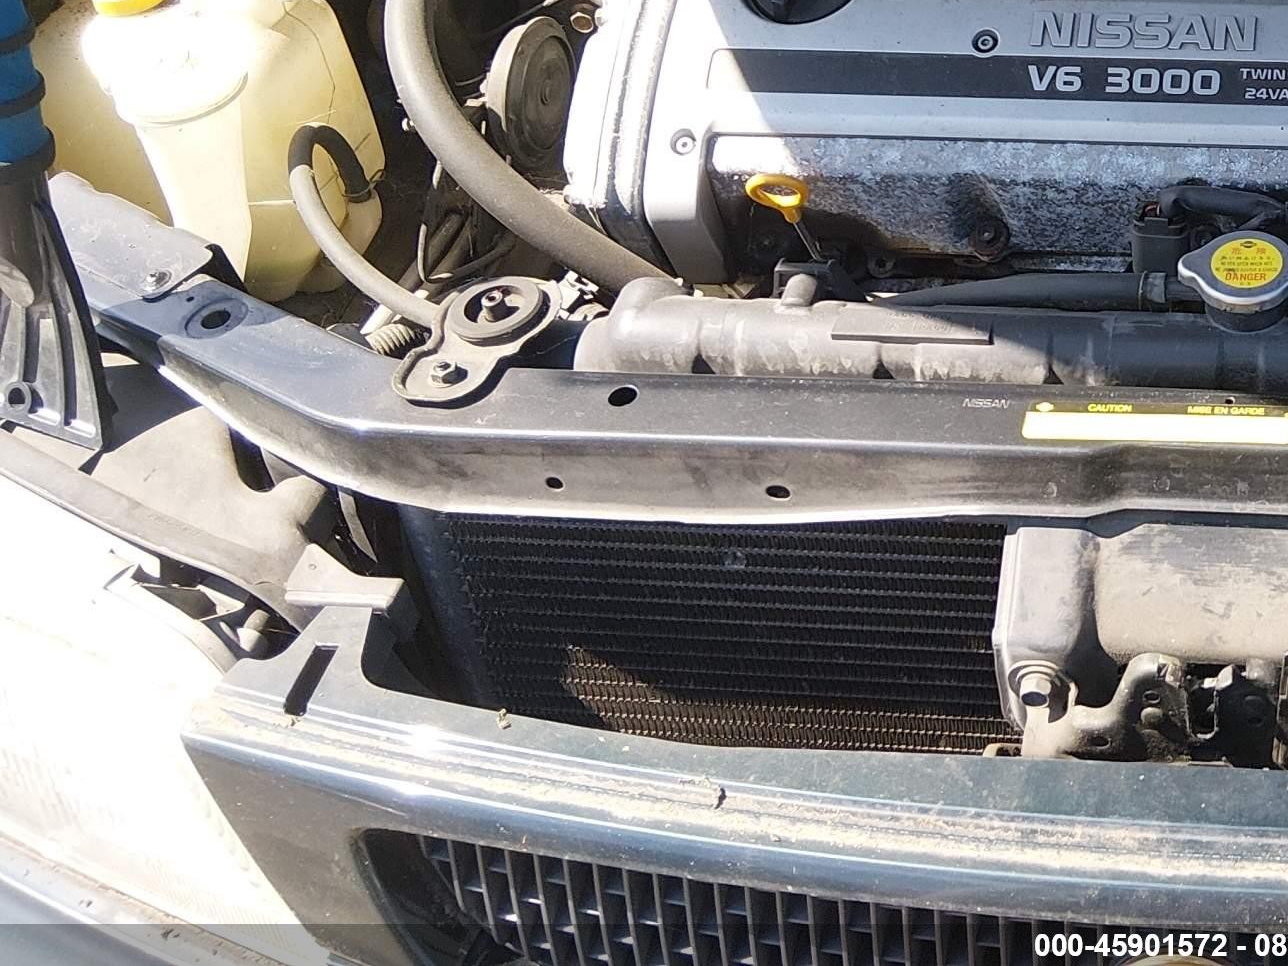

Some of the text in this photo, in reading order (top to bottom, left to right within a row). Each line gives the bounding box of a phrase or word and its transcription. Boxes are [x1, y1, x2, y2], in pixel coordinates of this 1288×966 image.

[1029, 10, 1259, 52] NISSAN
[1027, 64, 1222, 96] V6 3000
[1239, 68, 1287, 82] TWIN
[1225, 273, 1266, 281] DANGER
[962, 398, 1010, 410] NISSAN
[1087, 404, 1133, 412] CAUTION
[1187, 406, 1266, 416] MISE EN GARDE
